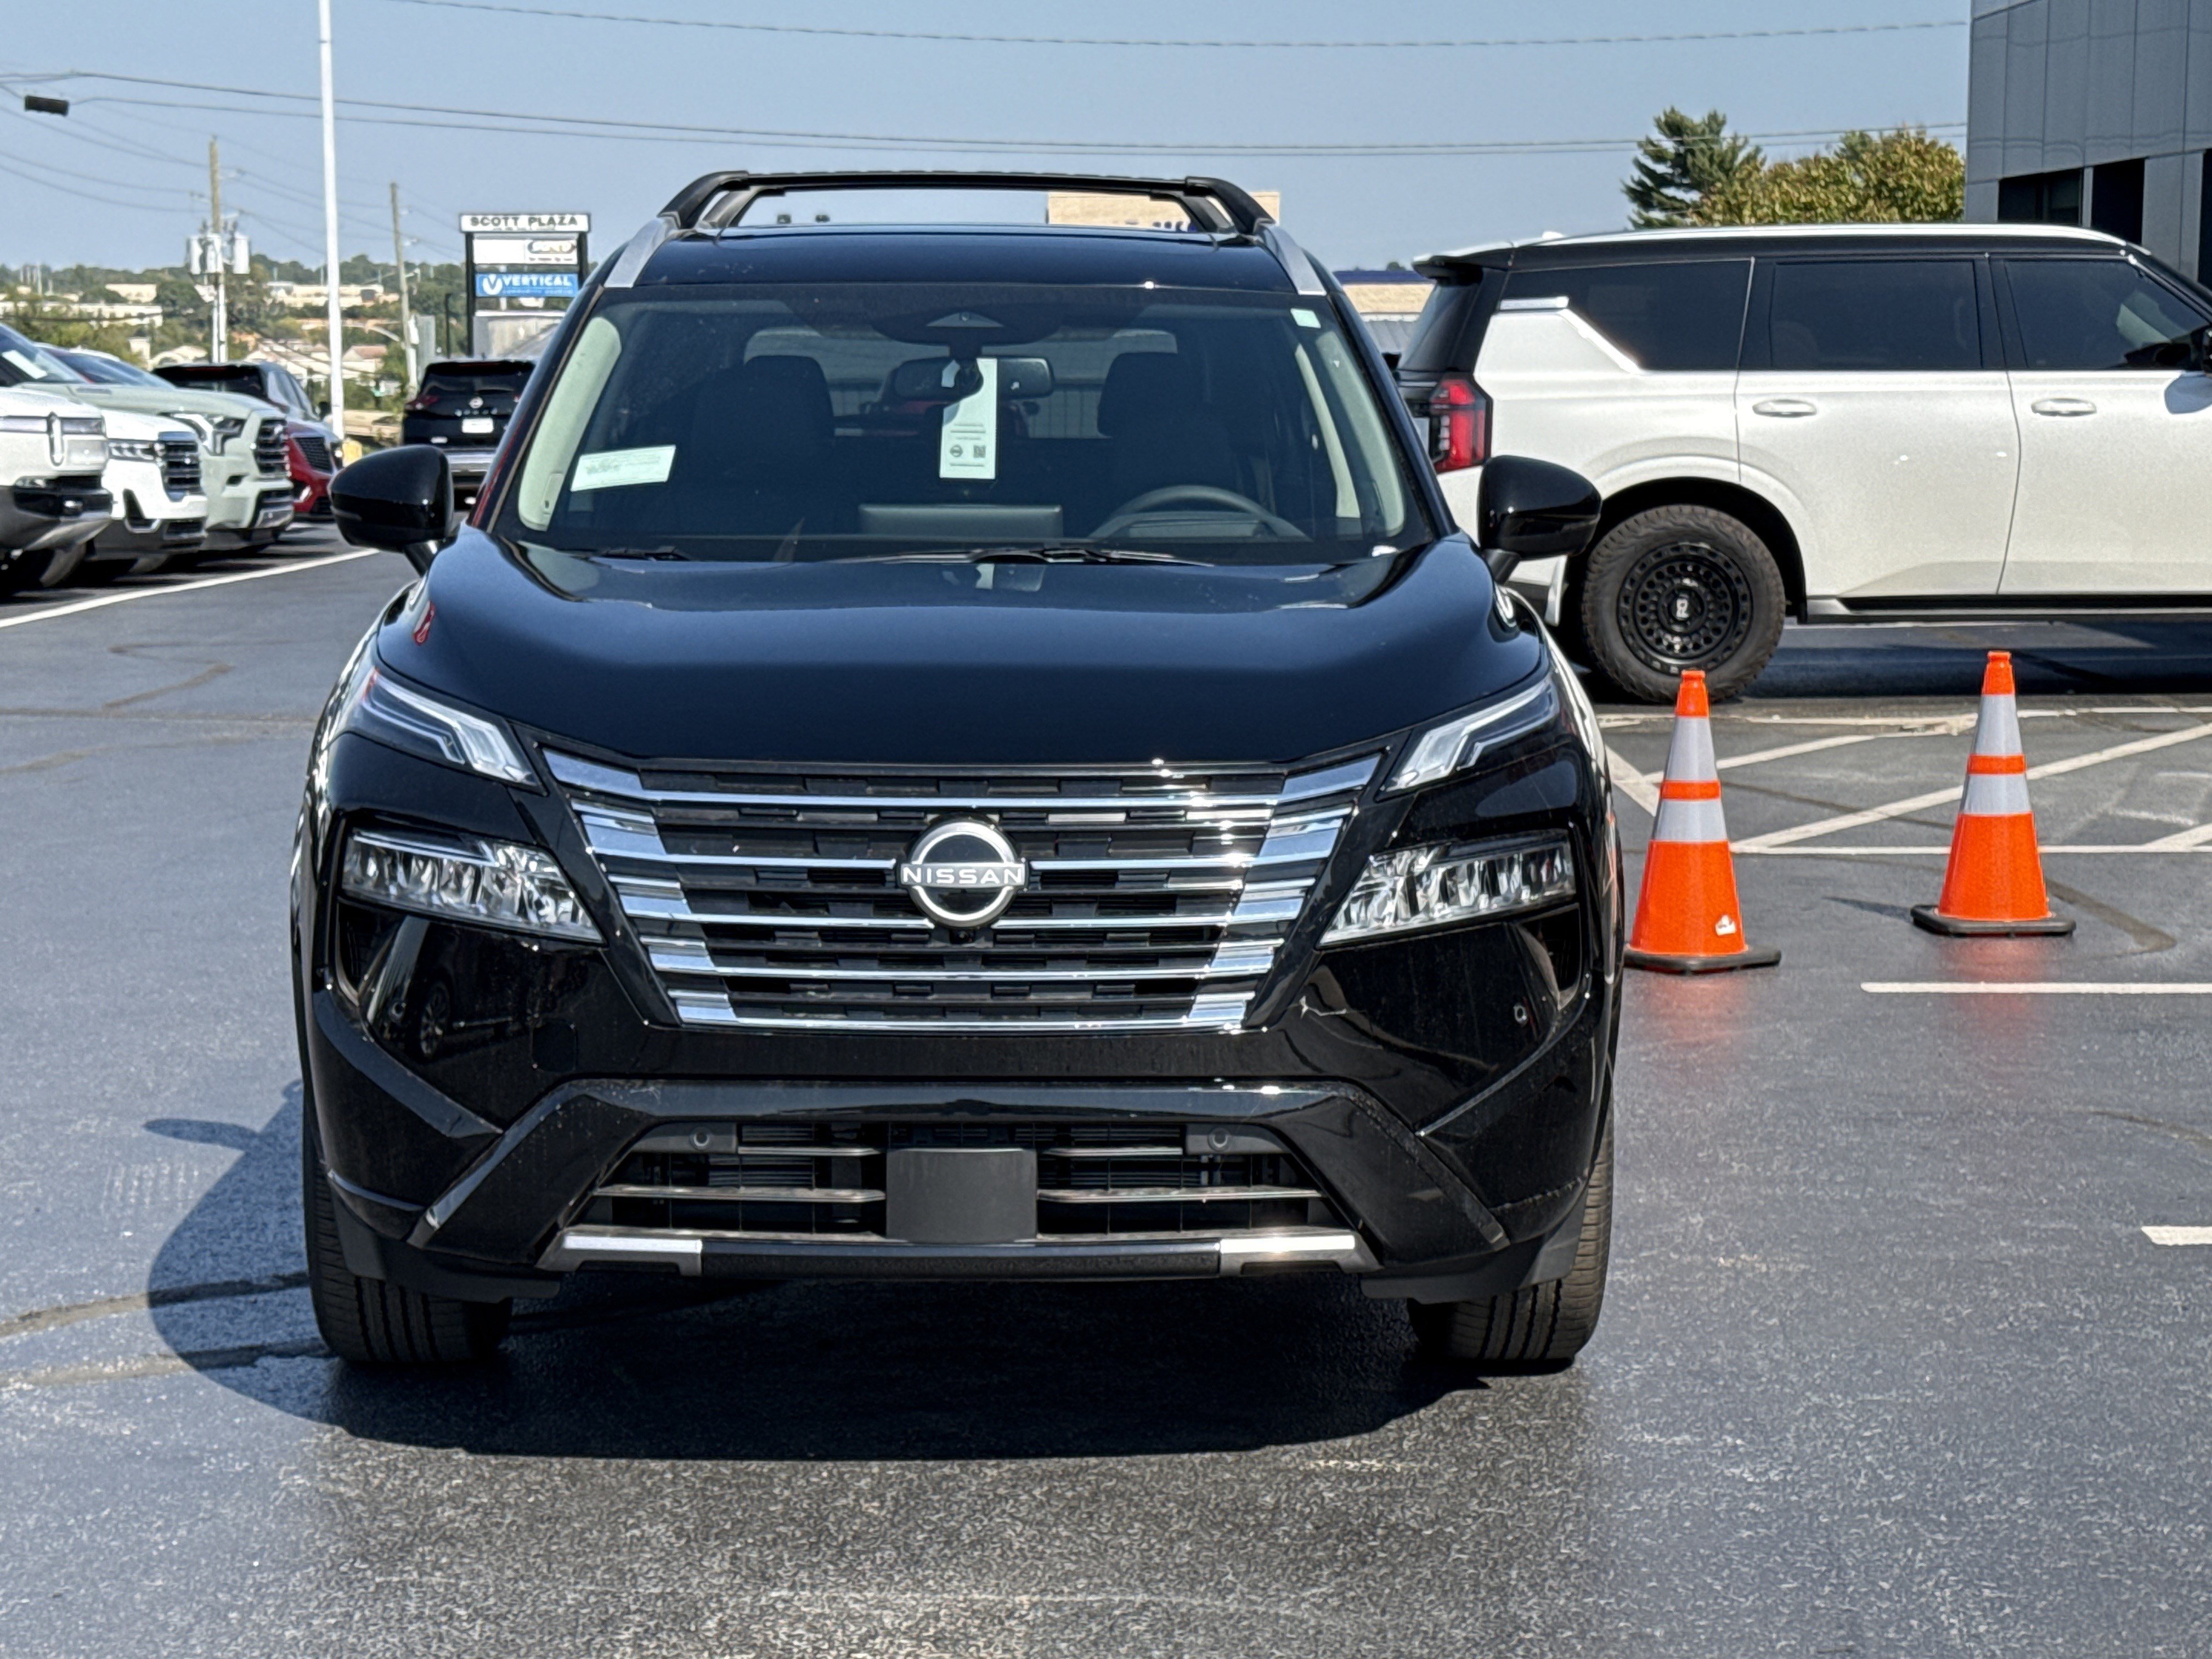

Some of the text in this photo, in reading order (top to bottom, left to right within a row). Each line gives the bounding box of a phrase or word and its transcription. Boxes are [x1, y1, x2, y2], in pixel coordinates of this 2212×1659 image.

[470, 216, 578, 227] SCOTT PLAZA
[502, 274, 572, 286] VERTICAL
[902, 867, 1022, 884] NISSAN
